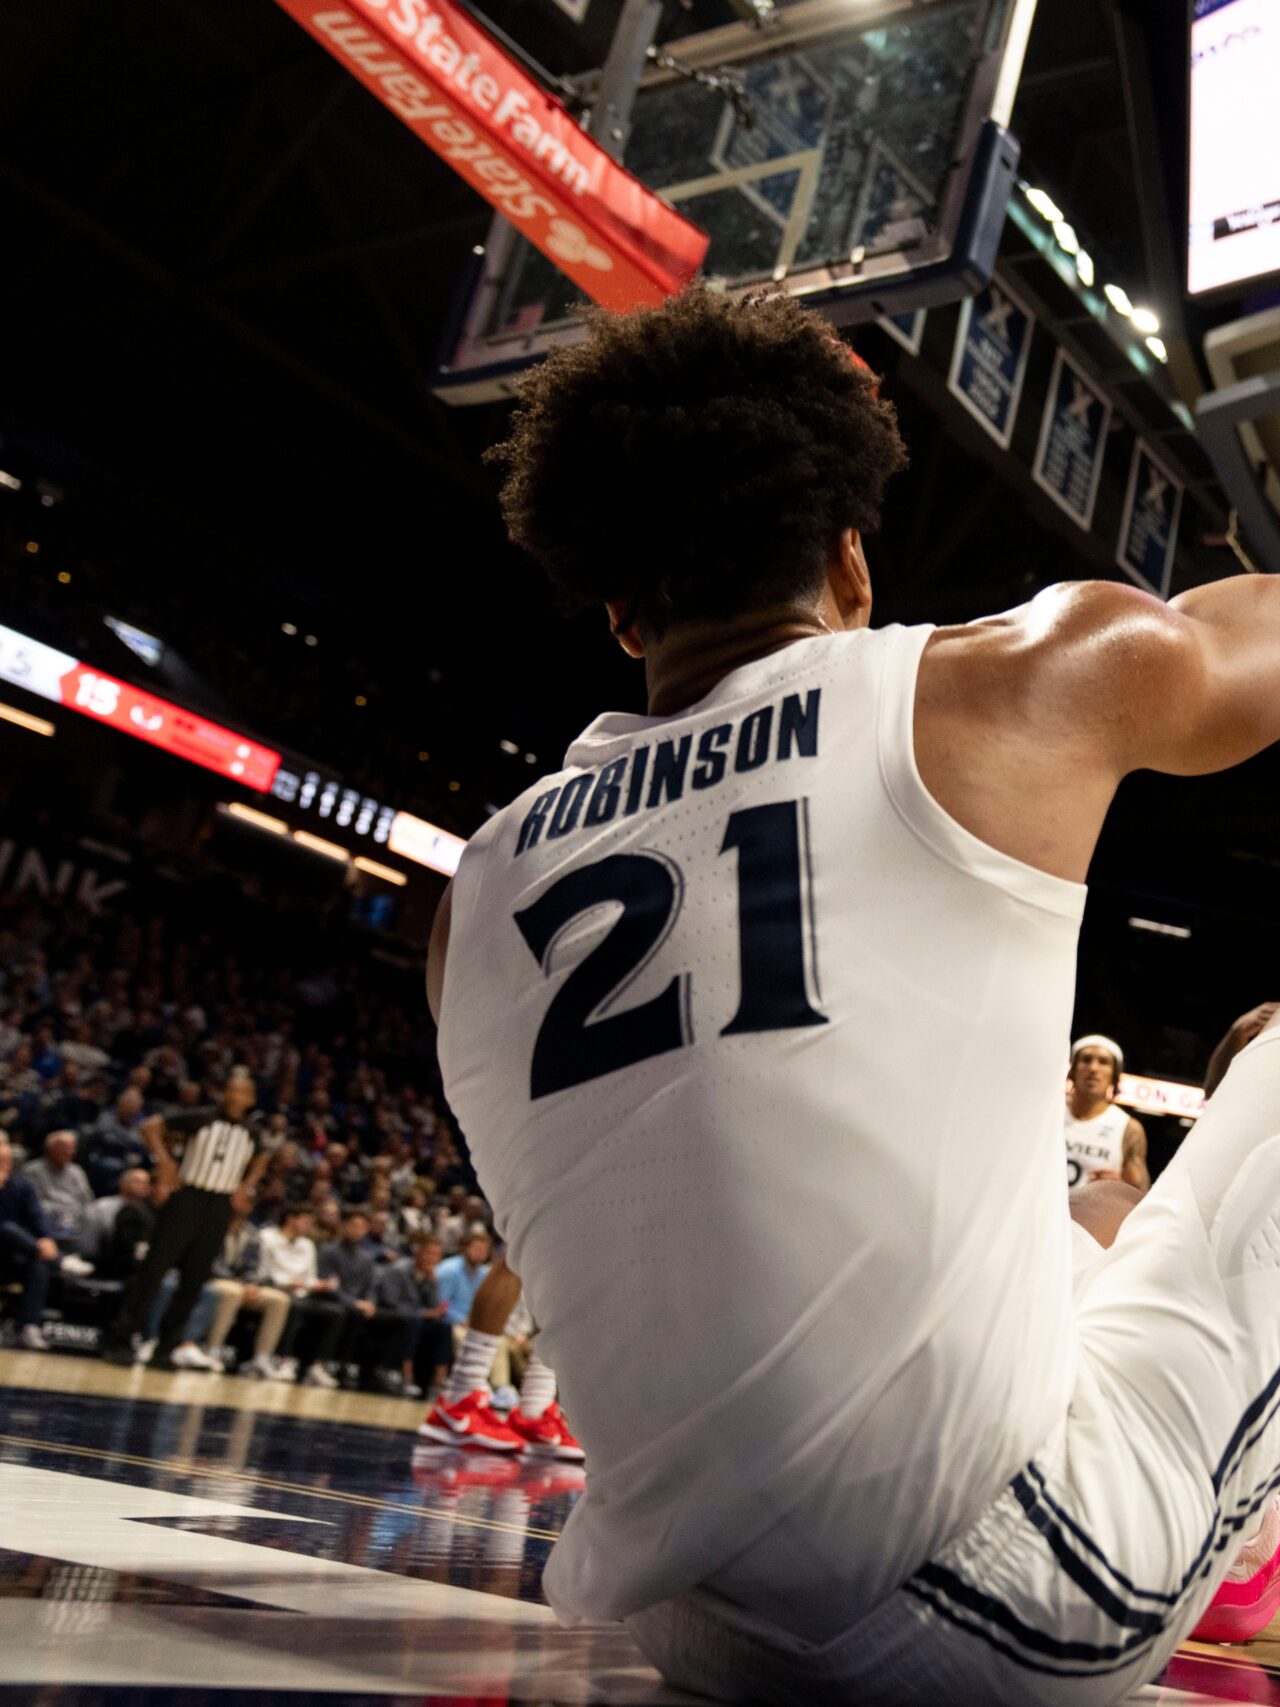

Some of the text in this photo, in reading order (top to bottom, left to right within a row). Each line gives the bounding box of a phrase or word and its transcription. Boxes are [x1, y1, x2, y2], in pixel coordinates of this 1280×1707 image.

[75, 672, 121, 716] 15
[513, 687, 823, 859] ROBINSON
[511, 796, 831, 1102] 21
